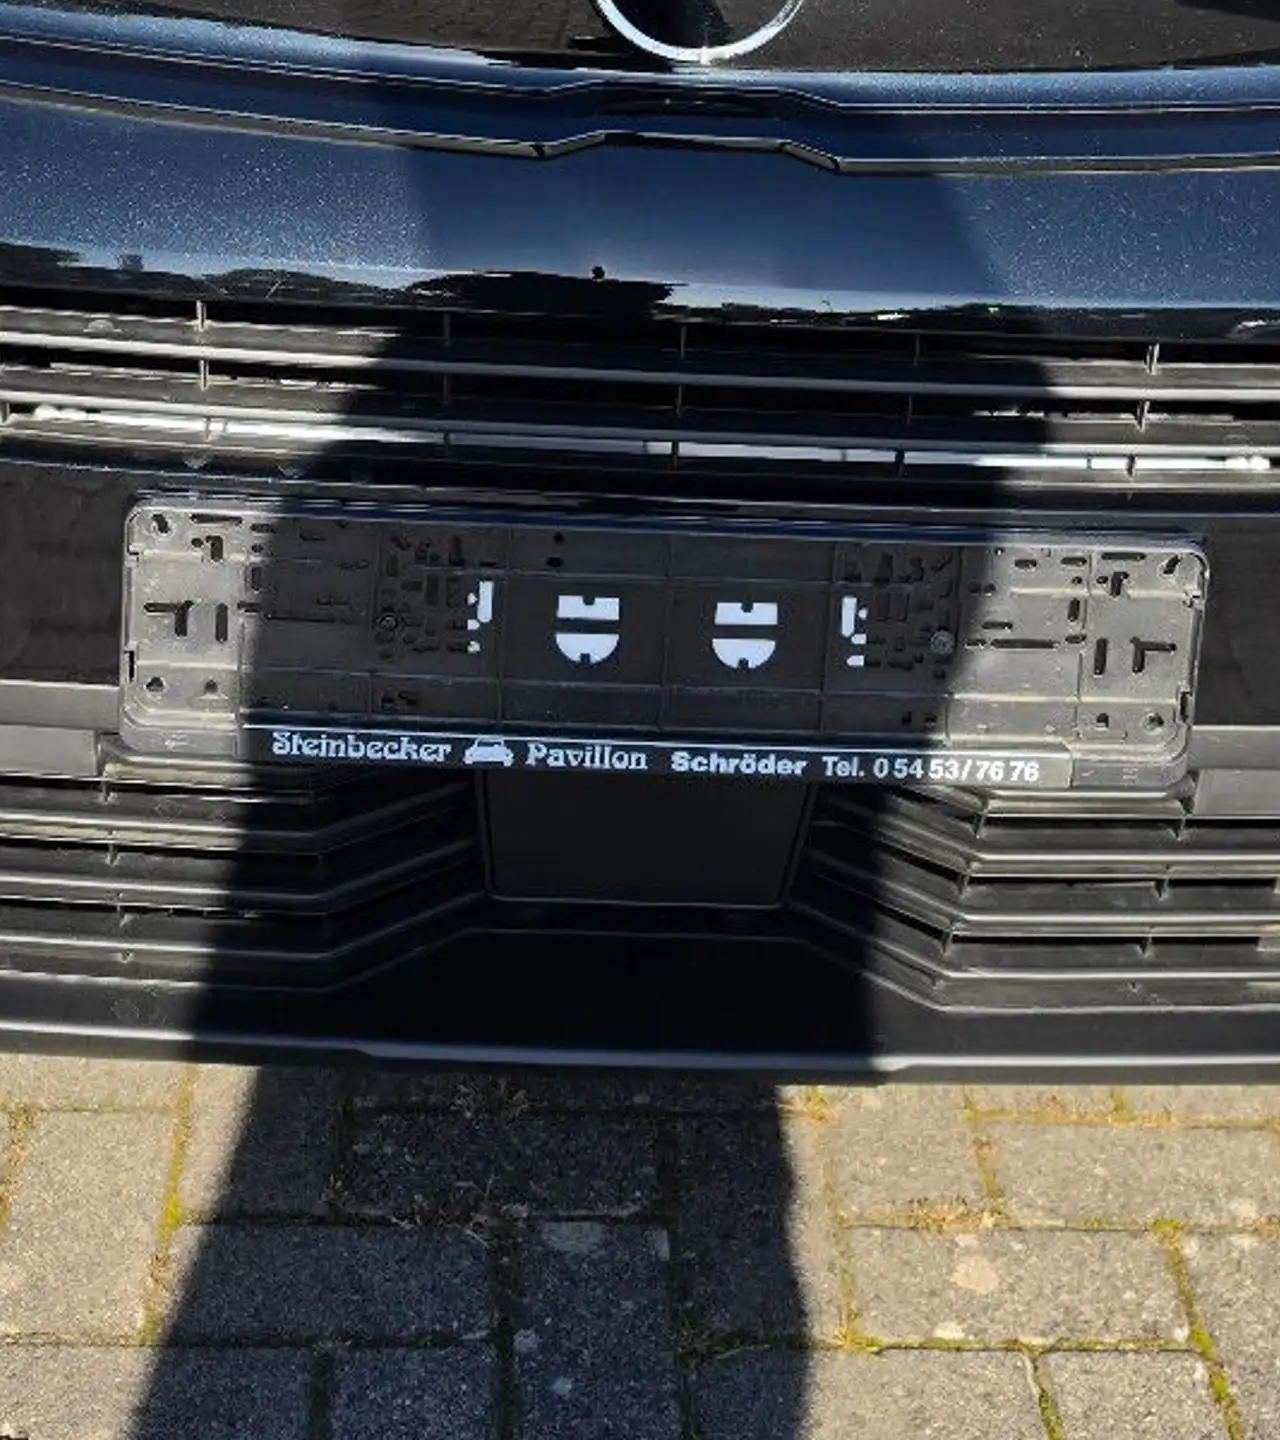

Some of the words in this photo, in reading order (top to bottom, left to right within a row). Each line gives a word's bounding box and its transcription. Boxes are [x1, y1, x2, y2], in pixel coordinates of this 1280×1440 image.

[272, 731, 451, 762] Steinbecker
[525, 741, 648, 771] Pavillon
[670, 749, 807, 776] Schröder
[822, 755, 865, 778] Tel.
